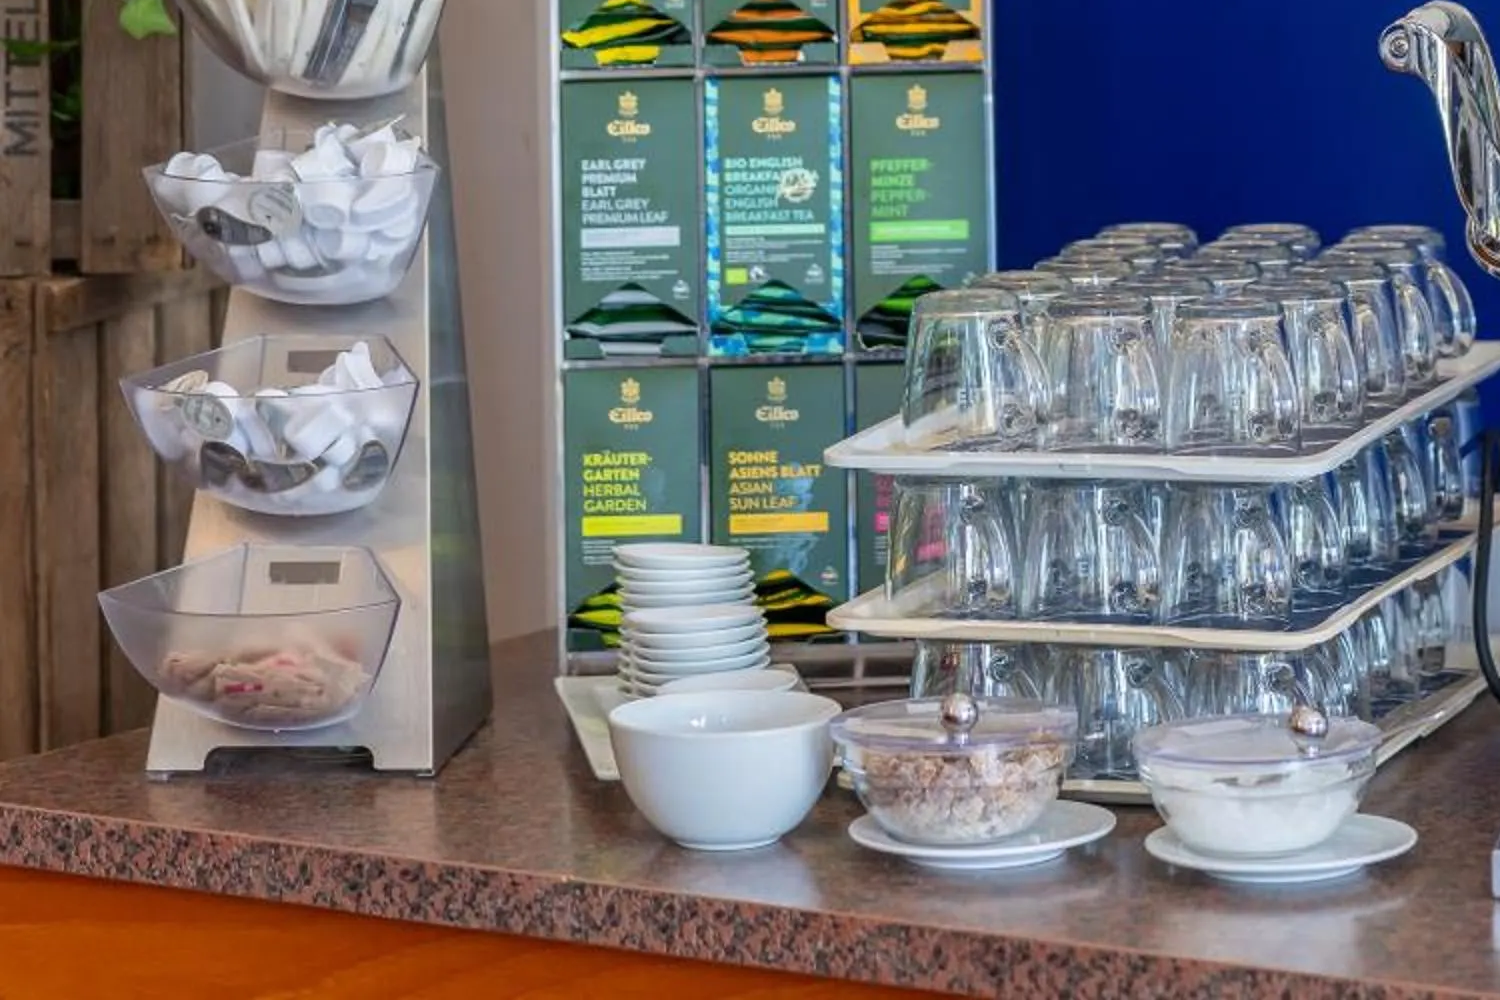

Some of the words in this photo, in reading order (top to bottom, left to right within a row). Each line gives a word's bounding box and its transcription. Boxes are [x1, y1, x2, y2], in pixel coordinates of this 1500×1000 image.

[581, 158, 615, 171] EARL
[616, 157, 646, 170] GREY
[581, 171, 637, 184] PREMIUM
[581, 185, 617, 198] BLATT
[581, 199, 617, 212] EARL
[618, 198, 650, 210] GREY
[581, 213, 639, 225] PREMIUM
[641, 211, 669, 223] LEAF
[582, 451, 653, 468] KRÄUTER-
[728, 451, 778, 465] SONNE
[582, 468, 640, 482] GARTEN
[729, 466, 778, 480] ASIENS
[780, 464, 822, 479] BLATT
[582, 483, 641, 497] HERBAL
[728, 481, 773, 495] ASIAN
[582, 498, 647, 513] GARDEN
[728, 497, 760, 510] SUN
